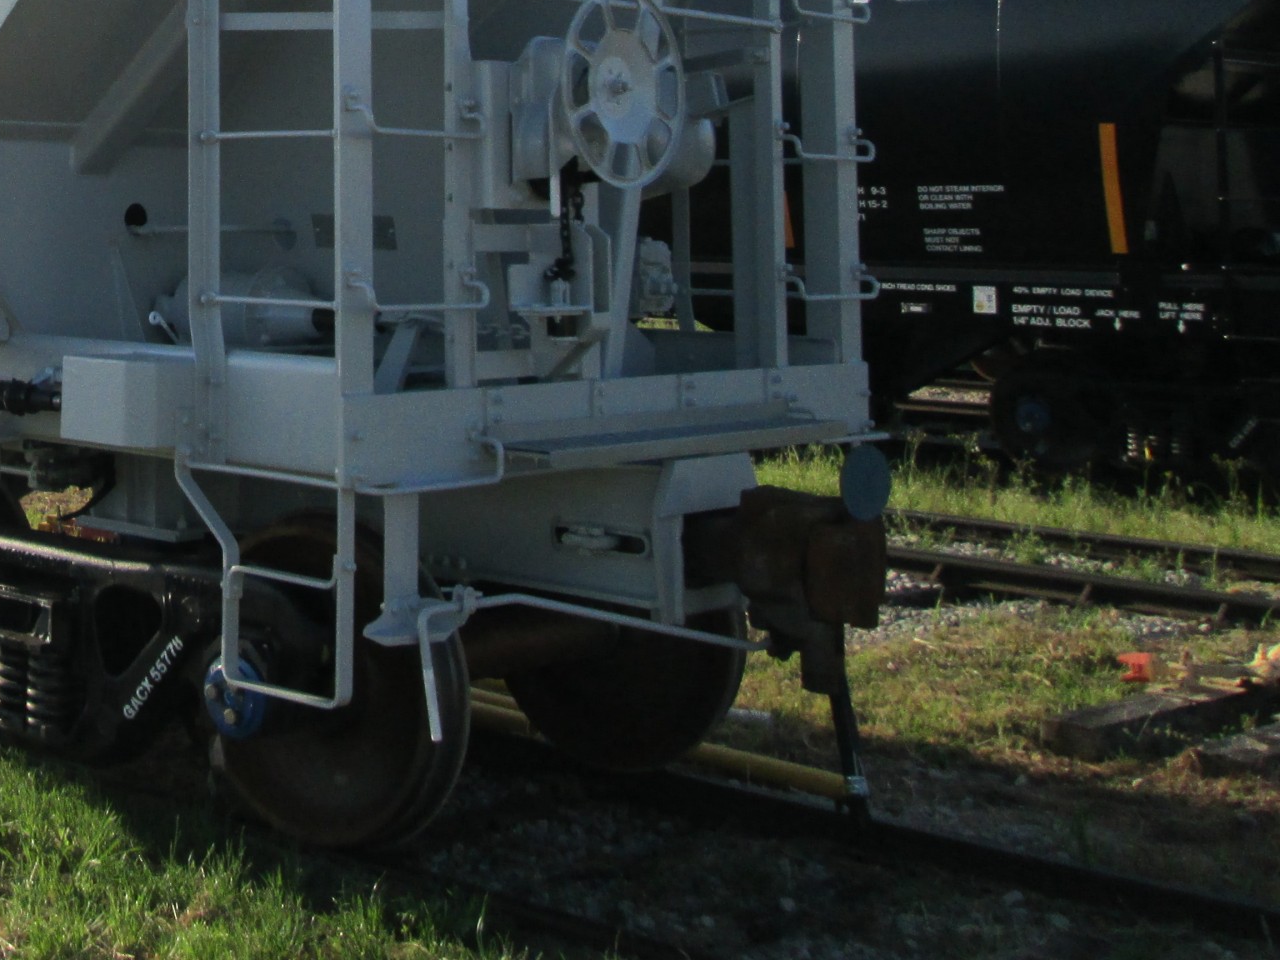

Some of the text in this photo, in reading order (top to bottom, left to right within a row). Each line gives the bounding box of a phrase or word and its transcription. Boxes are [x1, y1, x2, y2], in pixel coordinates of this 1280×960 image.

[1011, 304, 1045, 314] EMPTY
[1053, 305, 1081, 316] LOAD
[1055, 317, 1091, 329] BLOCK
[123, 676, 154, 719] GACX
